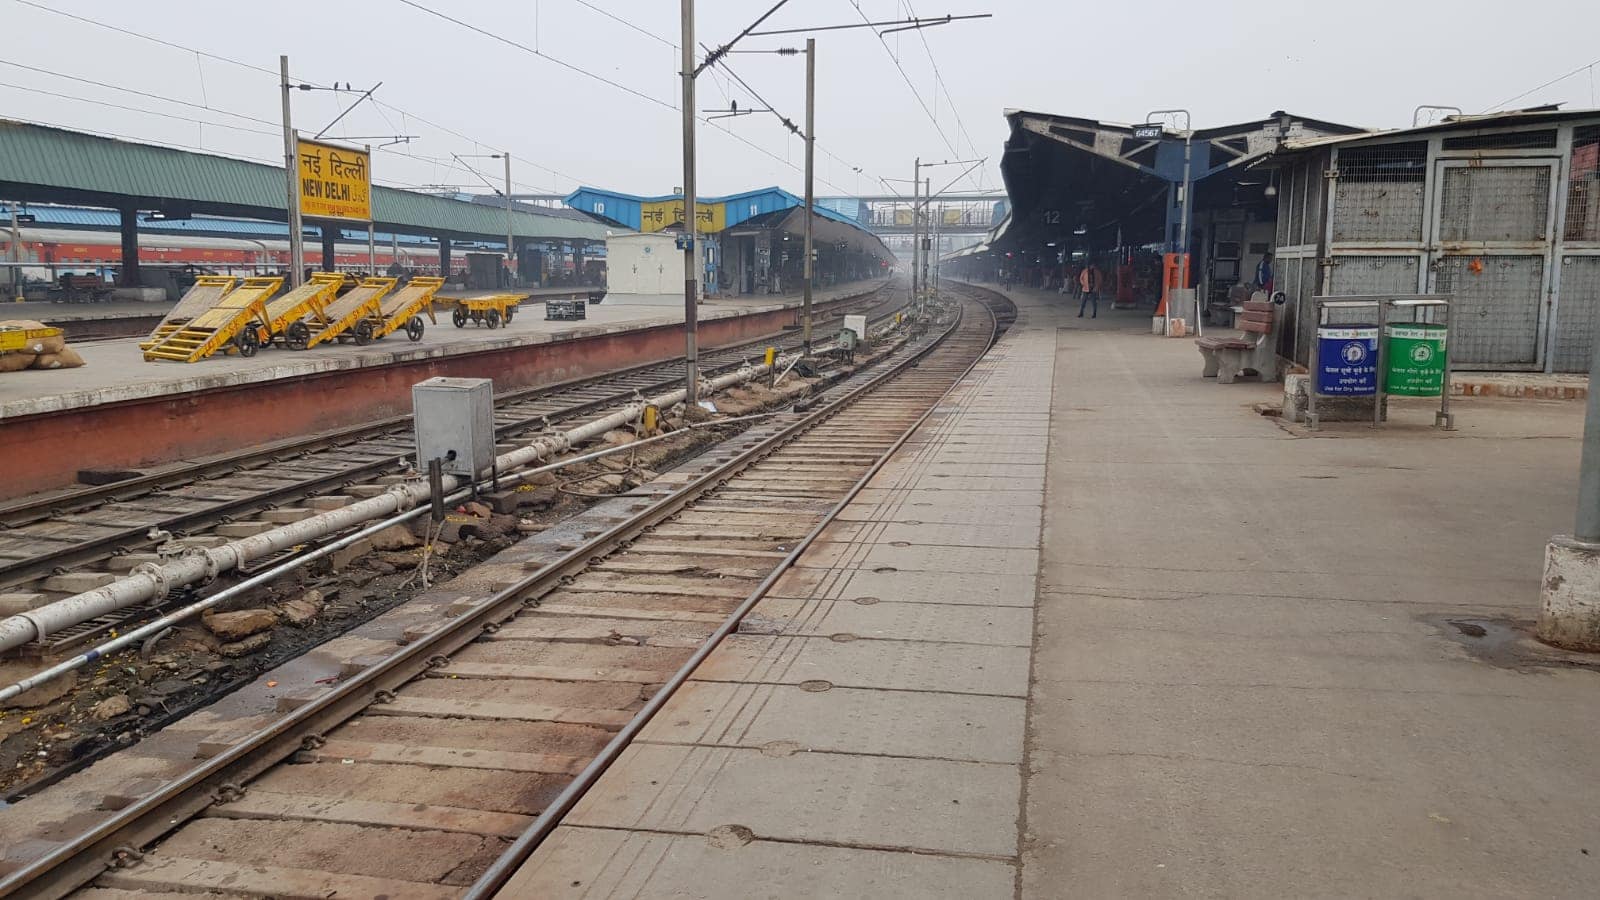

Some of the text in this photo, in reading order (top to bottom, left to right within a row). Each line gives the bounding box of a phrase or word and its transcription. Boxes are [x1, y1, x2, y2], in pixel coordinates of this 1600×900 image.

[301, 149, 365, 182] नई दिल्ली
[303, 178, 322, 198] NEW
[325, 181, 350, 201] DELHI
[593, 202, 605, 214] 10
[643, 207, 664, 224] नई
[750, 205, 758, 216] 11
[1043, 210, 1060, 224] 12
